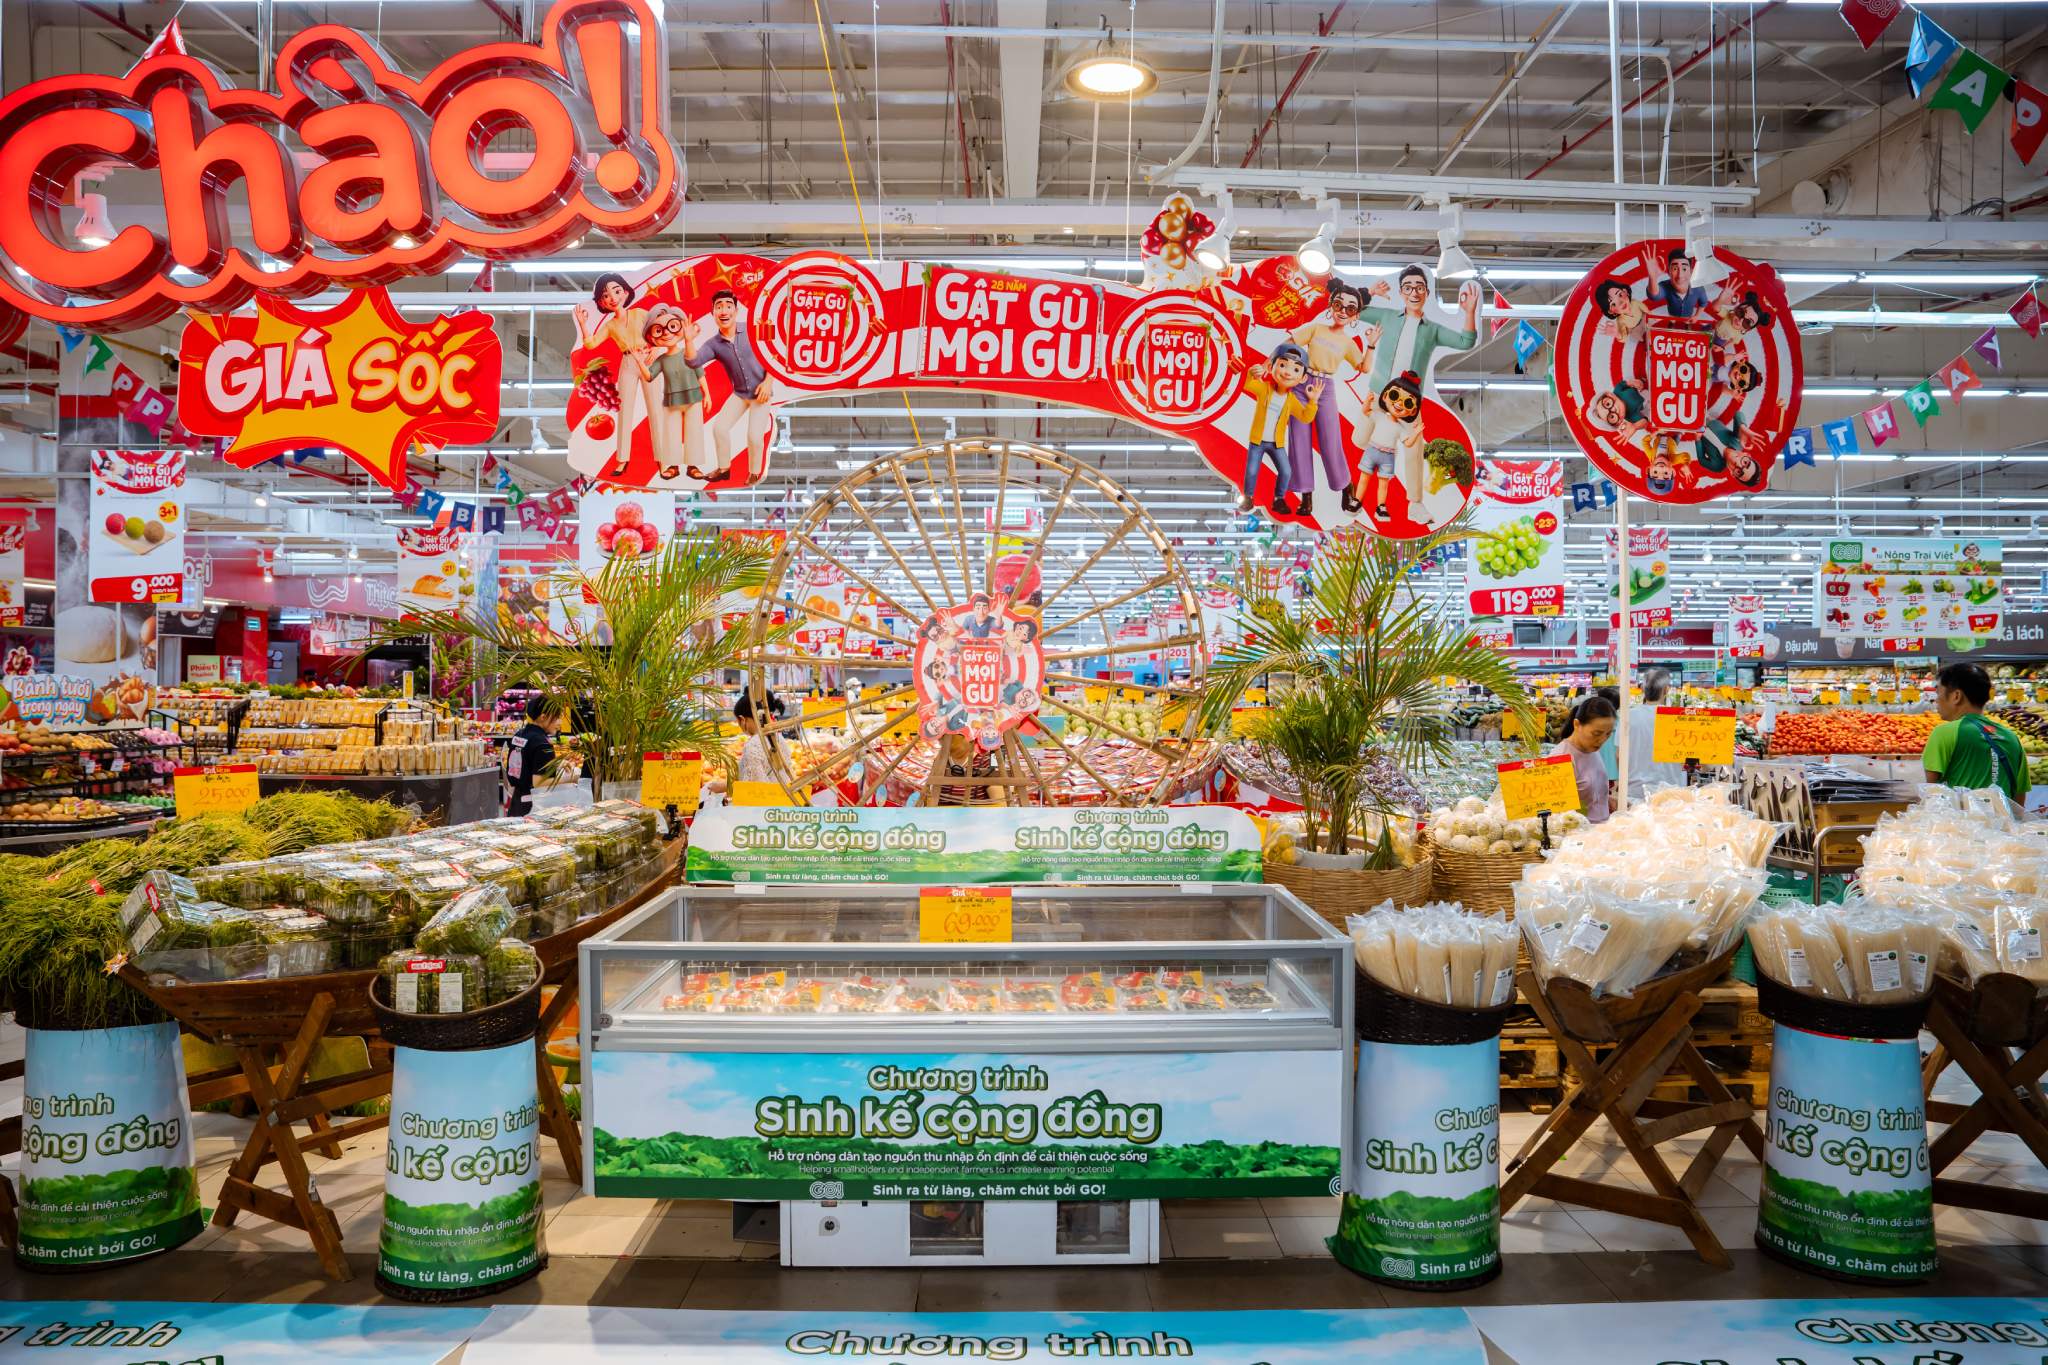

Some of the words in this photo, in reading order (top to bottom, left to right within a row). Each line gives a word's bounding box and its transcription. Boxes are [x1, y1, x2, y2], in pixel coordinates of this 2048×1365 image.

[0, 18, 641, 288] Chào!
[794, 290, 823, 309] GẬT
[825, 293, 846, 310] GÙ
[935, 273, 1019, 324] GẬT
[1030, 284, 1089, 331] GÙ
[795, 313, 839, 336] MỌI
[1151, 328, 1182, 350] GẬT
[1183, 330, 1204, 349] GÙ
[1653, 335, 1683, 357] GẬT
[1685, 336, 1707, 359] GÙ
[205, 327, 333, 414] GIÁ
[352, 316, 477, 409] SỐC
[794, 340, 836, 368] GU
[929, 327, 1014, 374] MỌI
[1021, 331, 1093, 380] GU
[1153, 350, 1196, 376] MỌI
[1657, 361, 1700, 389] MỌI
[1153, 380, 1195, 407] GU
[1657, 392, 1697, 424] GU
[1534, 485, 1550, 497] GU
[160, 505, 177, 518] 3+1
[2016, 623, 2044, 641] lách
[966, 665, 995, 682] MỌI
[12, 677, 57, 700] Bánh
[966, 684, 994, 704] GU
[764, 810, 822, 825] Chương
[824, 809, 858, 824] trình
[1075, 811, 1132, 825] Chương
[1134, 810, 1168, 825] trình
[733, 826, 785, 849] Sinh
[789, 823, 820, 849] kế
[821, 826, 880, 852] cộng
[884, 823, 946, 852] đồng
[1015, 827, 1068, 850] Sinh
[1071, 824, 1104, 850] kế
[1104, 827, 1163, 853] cộng
[1167, 823, 1228, 852] đồng
[868, 1066, 976, 1094] Chương
[983, 1065, 1047, 1090] trình
[50, 1092, 114, 1117] trình
[757, 1097, 855, 1136] Sinh
[863, 1091, 923, 1137] kế
[926, 1095, 1037, 1144] cộng
[1044, 1091, 1162, 1143] đồng
[1776, 1087, 1871, 1132] Chương
[1878, 1107, 1923, 1131] trình
[96, 1115, 181, 1155] đồng
[401, 1112, 498, 1140] Chương
[768, 1150, 786, 1162] Hỗ
[787, 1152, 804, 1162] trợ
[806, 1151, 836, 1163] nông
[839, 1151, 861, 1162] dân
[863, 1152, 882, 1163] tạo
[885, 1150, 921, 1163] nguồn
[923, 1151, 942, 1162] thu
[945, 1151, 974, 1164] nhập
[976, 1149, 991, 1162] ổn
[994, 1151, 1019, 1164] định
[1022, 1149, 1037, 1162] để
[1039, 1150, 1056, 1162] cải
[1058, 1151, 1087, 1163] thiện
[1089, 1151, 1117, 1163] cuộc
[1119, 1149, 1148, 1163] sống
[1366, 1139, 1437, 1175] Sinh
[1444, 1133, 1485, 1174] kế
[1777, 1120, 1818, 1158] kế
[1820, 1137, 1912, 1179] cộng
[404, 1144, 449, 1181] kế
[451, 1143, 532, 1185] cộng
[800, 1165, 832, 1175] Helping
[833, 1165, 886, 1174] smallholders
[888, 1165, 904, 1174] and
[906, 1165, 959, 1175] independent
[961, 1165, 994, 1174] farmers
[996, 1166, 1006, 1174] to
[1007, 1165, 1041, 1174] increase
[1043, 1165, 1075, 1175] earning
[1077, 1165, 1115, 1175] potential
[873, 1184, 902, 1196] Sinh
[906, 1187, 920, 1196] ra
[923, 1184, 939, 1196] từ
[942, 1184, 975, 1198] làng,
[979, 1184, 1016, 1196] chăm
[1020, 1184, 1050, 1196] chút
[1054, 1183, 1076, 1196] bởi
[1080, 1184, 1106, 1196] GO!
[1391, 1218, 1415, 1230] nông
[1417, 1218, 1435, 1229] dân
[60, 1245, 94, 1258] chút
[99, 1240, 125, 1256] bởi
[129, 1233, 158, 1250] GO!
[404, 1270, 415, 1280] ra
[418, 1270, 435, 1282] từ
[478, 1263, 514, 1280] chăm
[1420, 1261, 1450, 1275] Sinh
[1453, 1263, 1466, 1273] ra
[1469, 1256, 1481, 1270] từ
[1845, 1258, 1887, 1272] chăm
[1891, 1260, 1917, 1273] chút
[24, 1320, 182, 1348] trình
[786, 1329, 1028, 1362] Chương
[1045, 1329, 1194, 1358] trình
[1795, 1317, 2048, 1348] Chương
